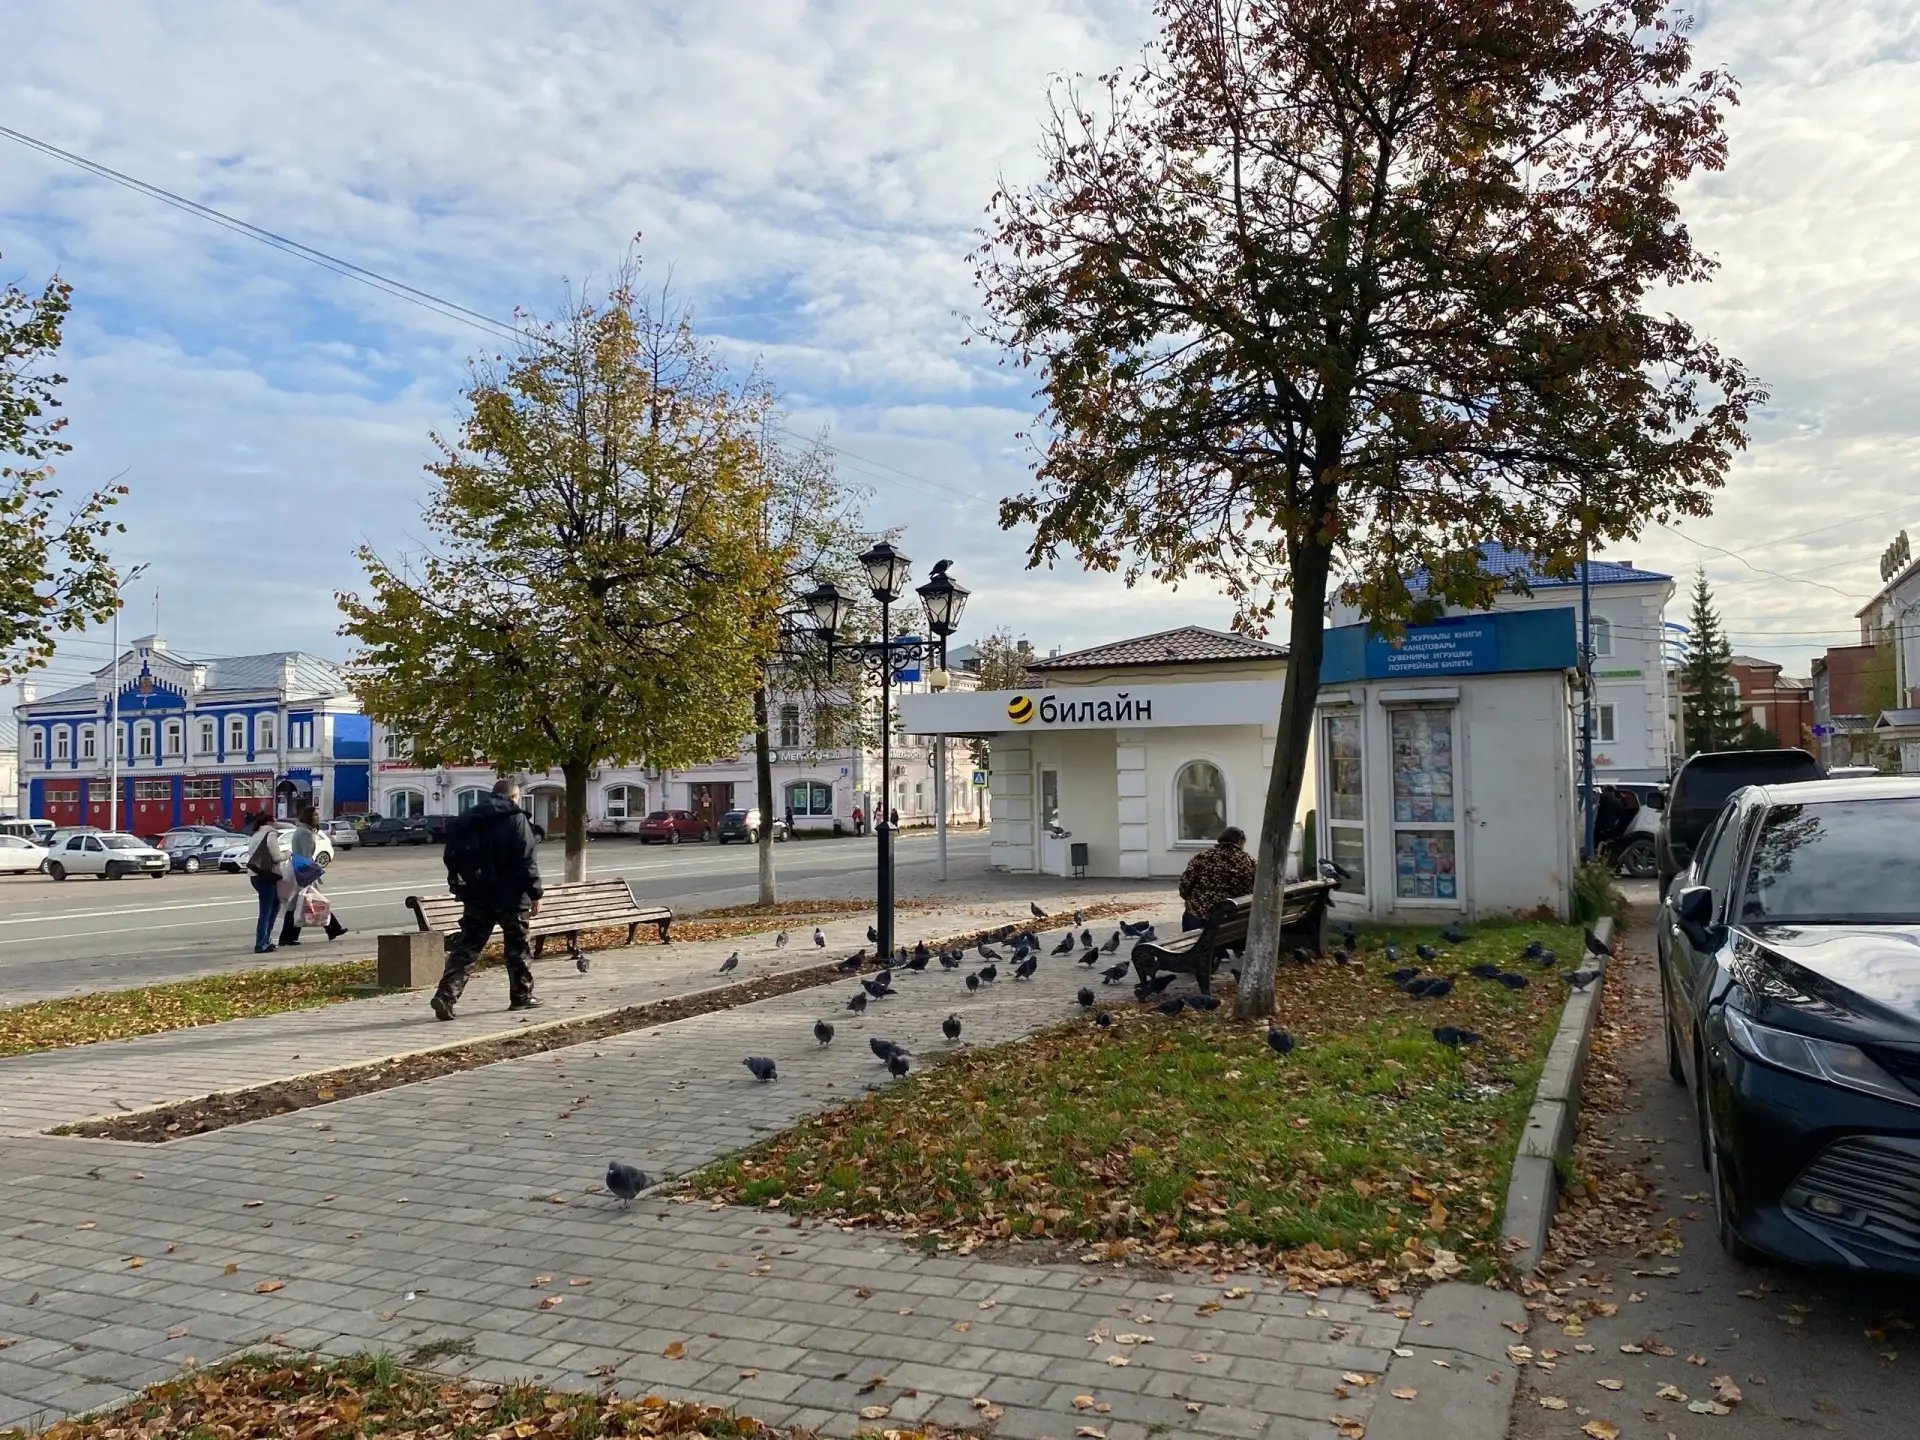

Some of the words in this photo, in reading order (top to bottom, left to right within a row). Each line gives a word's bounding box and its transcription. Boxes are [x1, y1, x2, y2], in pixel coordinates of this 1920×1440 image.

[1411, 633, 1451, 642] ЖУРНАЛЫ
[1454, 631, 1483, 639] КНИГИ
[1402, 642, 1456, 652] КАНЦТОВАРЫ
[1387, 653, 1430, 662] СУВЕНИРЫ
[1433, 650, 1473, 660] ИГРУШКИ
[1388, 662, 1440, 672] ЛОТЕРЕЙНЫЕ
[1441, 660, 1474, 668] БИЛЕТЫ
[1039, 692, 1152, 724] билайн
